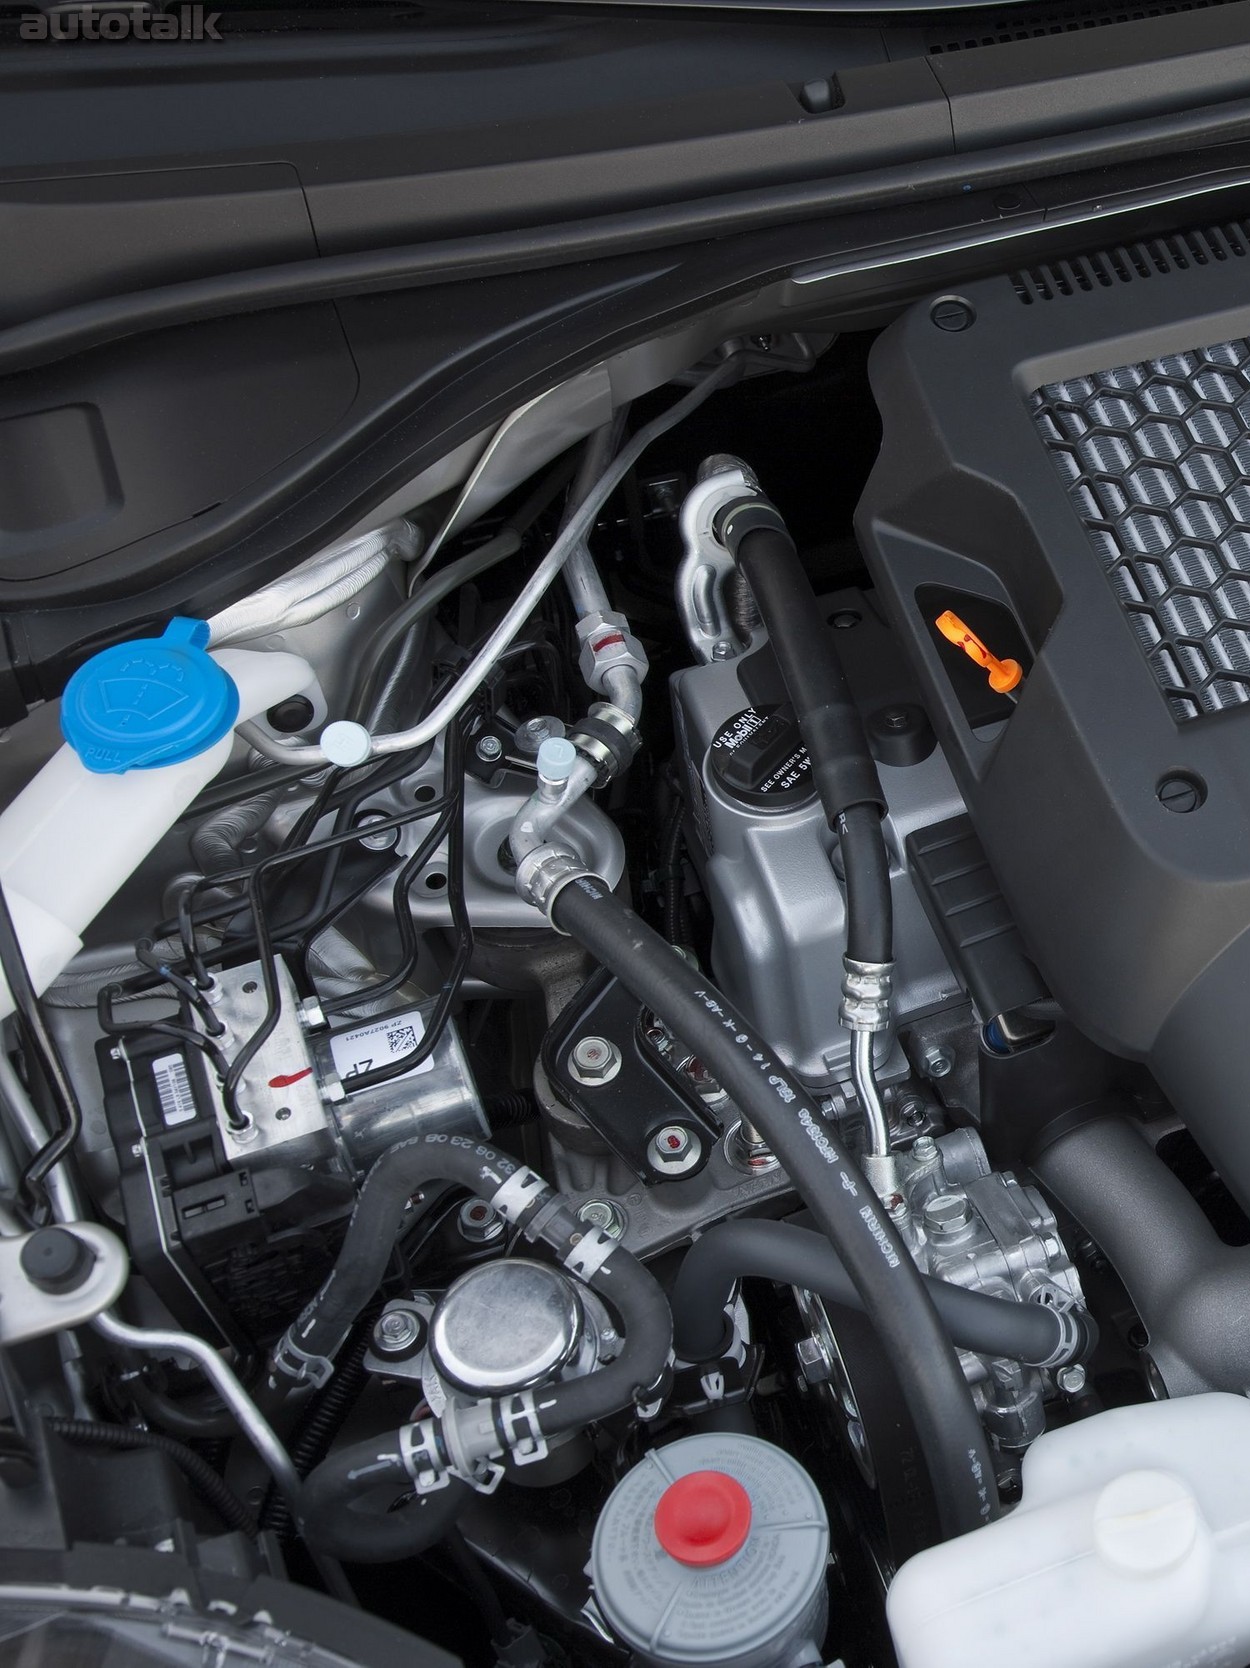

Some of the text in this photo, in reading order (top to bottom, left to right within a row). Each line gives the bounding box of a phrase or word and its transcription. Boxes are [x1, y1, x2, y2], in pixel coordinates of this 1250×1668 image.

[713, 707, 757, 748] USE ONLY
[724, 723, 753, 749] Mobil
[85, 748, 121, 763] PULL
[761, 780, 775, 792] SEE
[774, 753, 800, 780] OWNER'S
[781, 771, 800, 788] SAE
[450, 1136, 474, 1148] 23
[859, 1205, 900, 1268] NICHIRIN
[693, 1535, 760, 1588] ATTENTION
